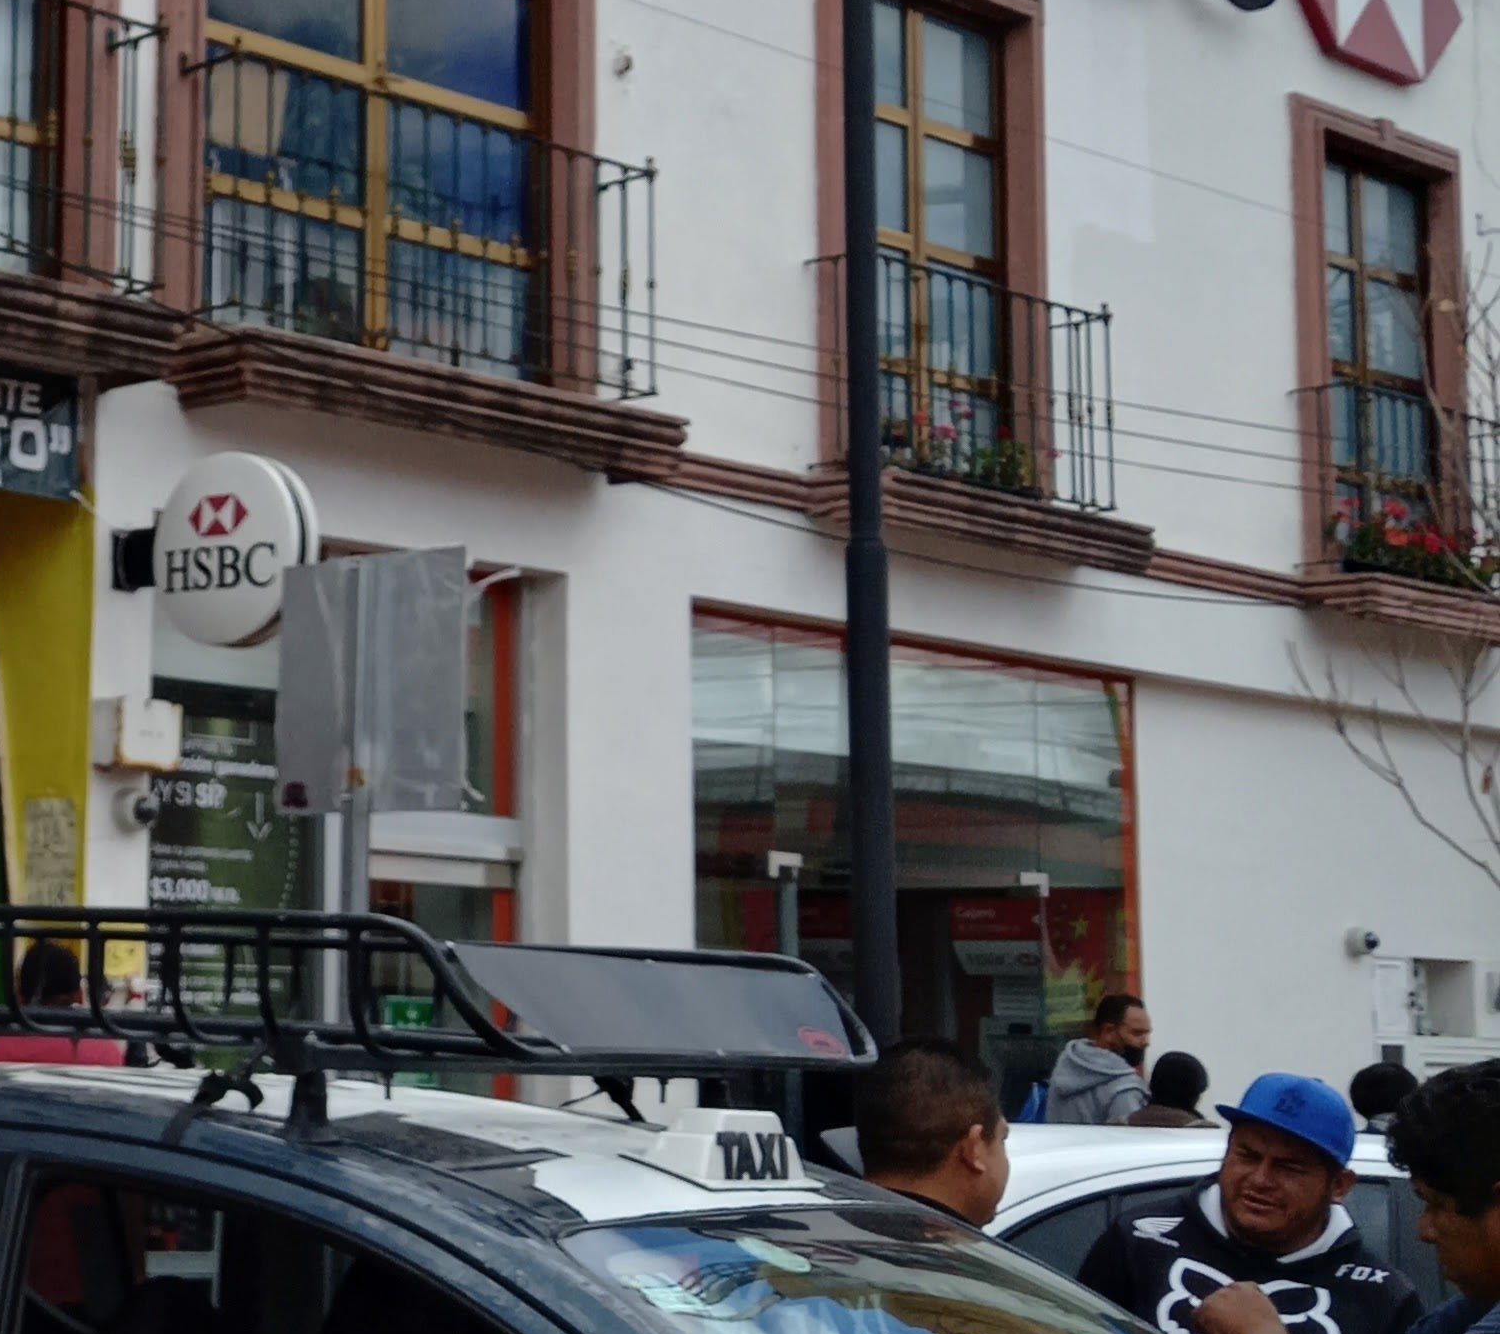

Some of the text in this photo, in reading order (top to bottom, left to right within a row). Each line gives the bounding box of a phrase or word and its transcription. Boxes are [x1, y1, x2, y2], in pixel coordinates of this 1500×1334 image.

[162, 541, 277, 594] HSBC
[715, 1130, 789, 1180] TAXI
[1334, 1262, 1391, 1284] FOX
